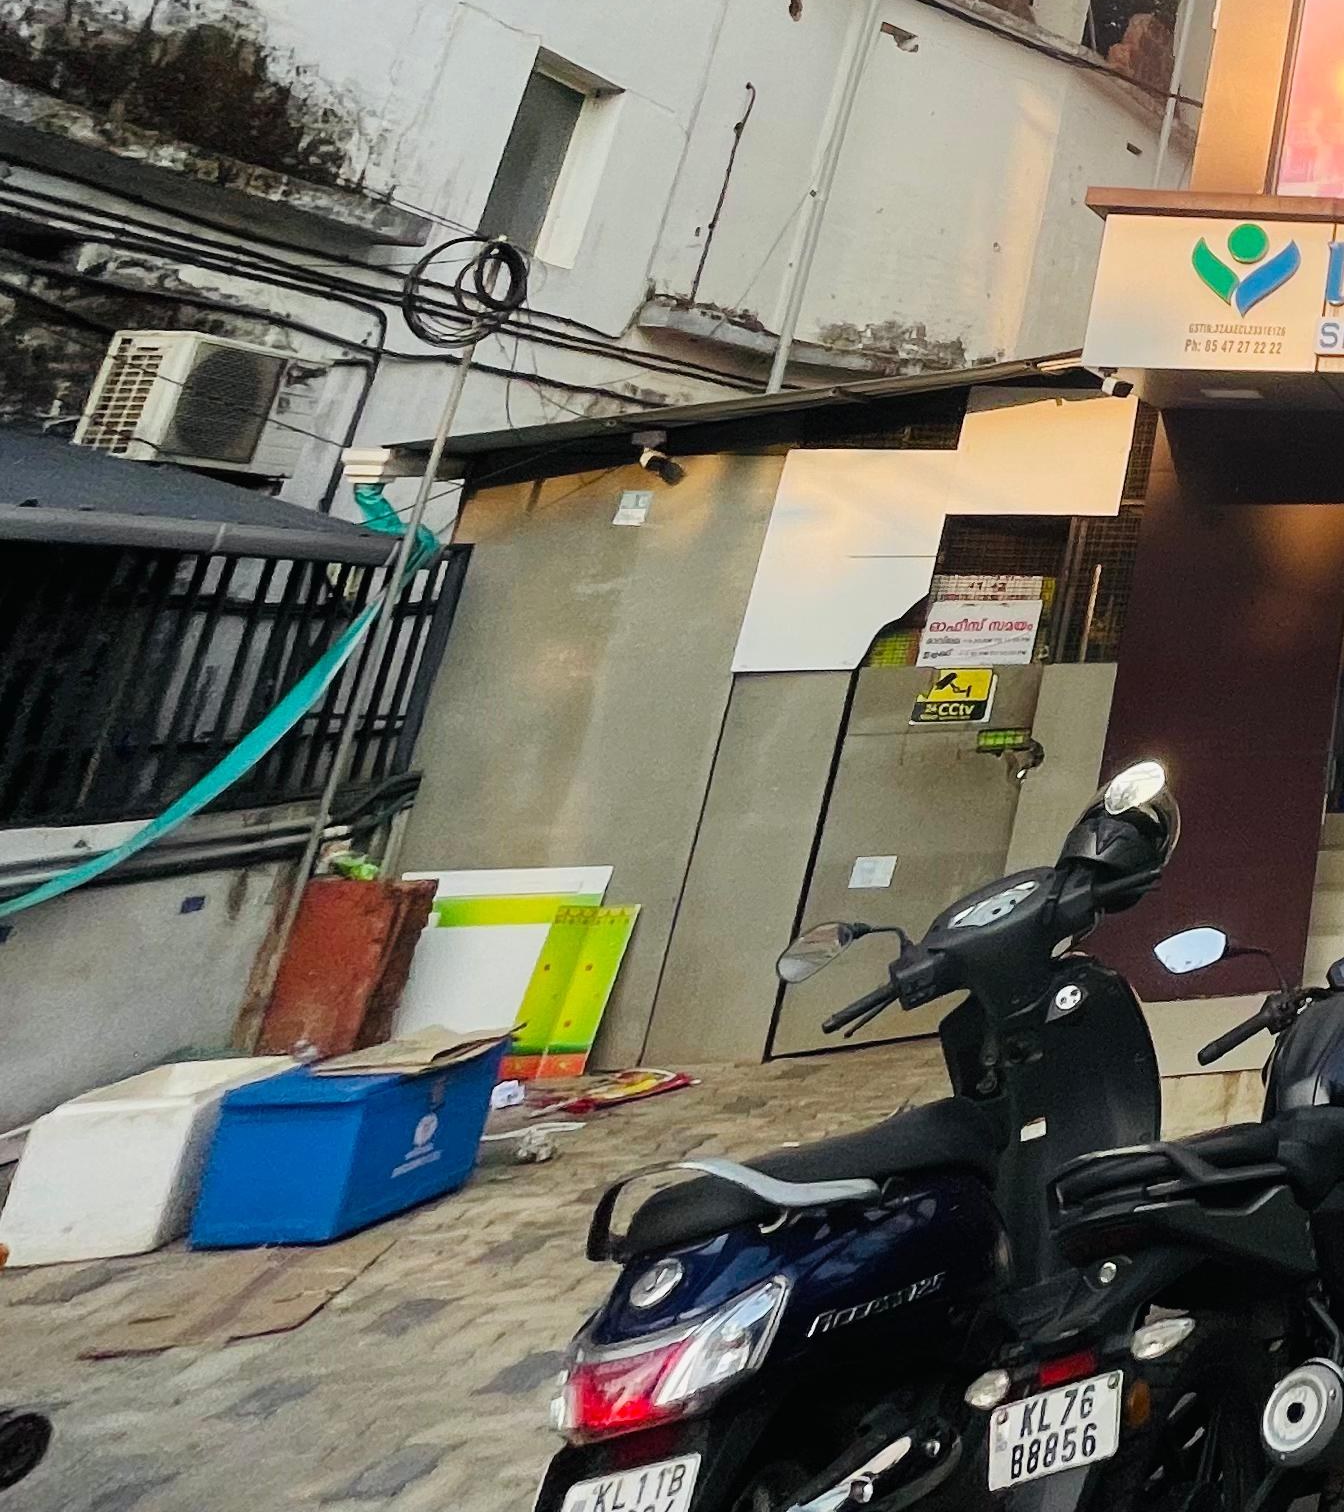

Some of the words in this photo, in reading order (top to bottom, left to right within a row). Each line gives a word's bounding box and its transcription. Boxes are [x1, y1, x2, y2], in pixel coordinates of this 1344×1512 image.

[1184, 338, 1201, 353] Ph:
[1204, 339, 1218, 353] 85
[1221, 340, 1235, 353] 47
[1237, 340, 1250, 354] 27
[1253, 341, 1267, 355] 22
[1269, 342, 1283, 355] 22
[1020, 1397, 1051, 1439] KL
[1060, 1384, 1096, 1426] 76
[592, 1477, 626, 1512] KL
